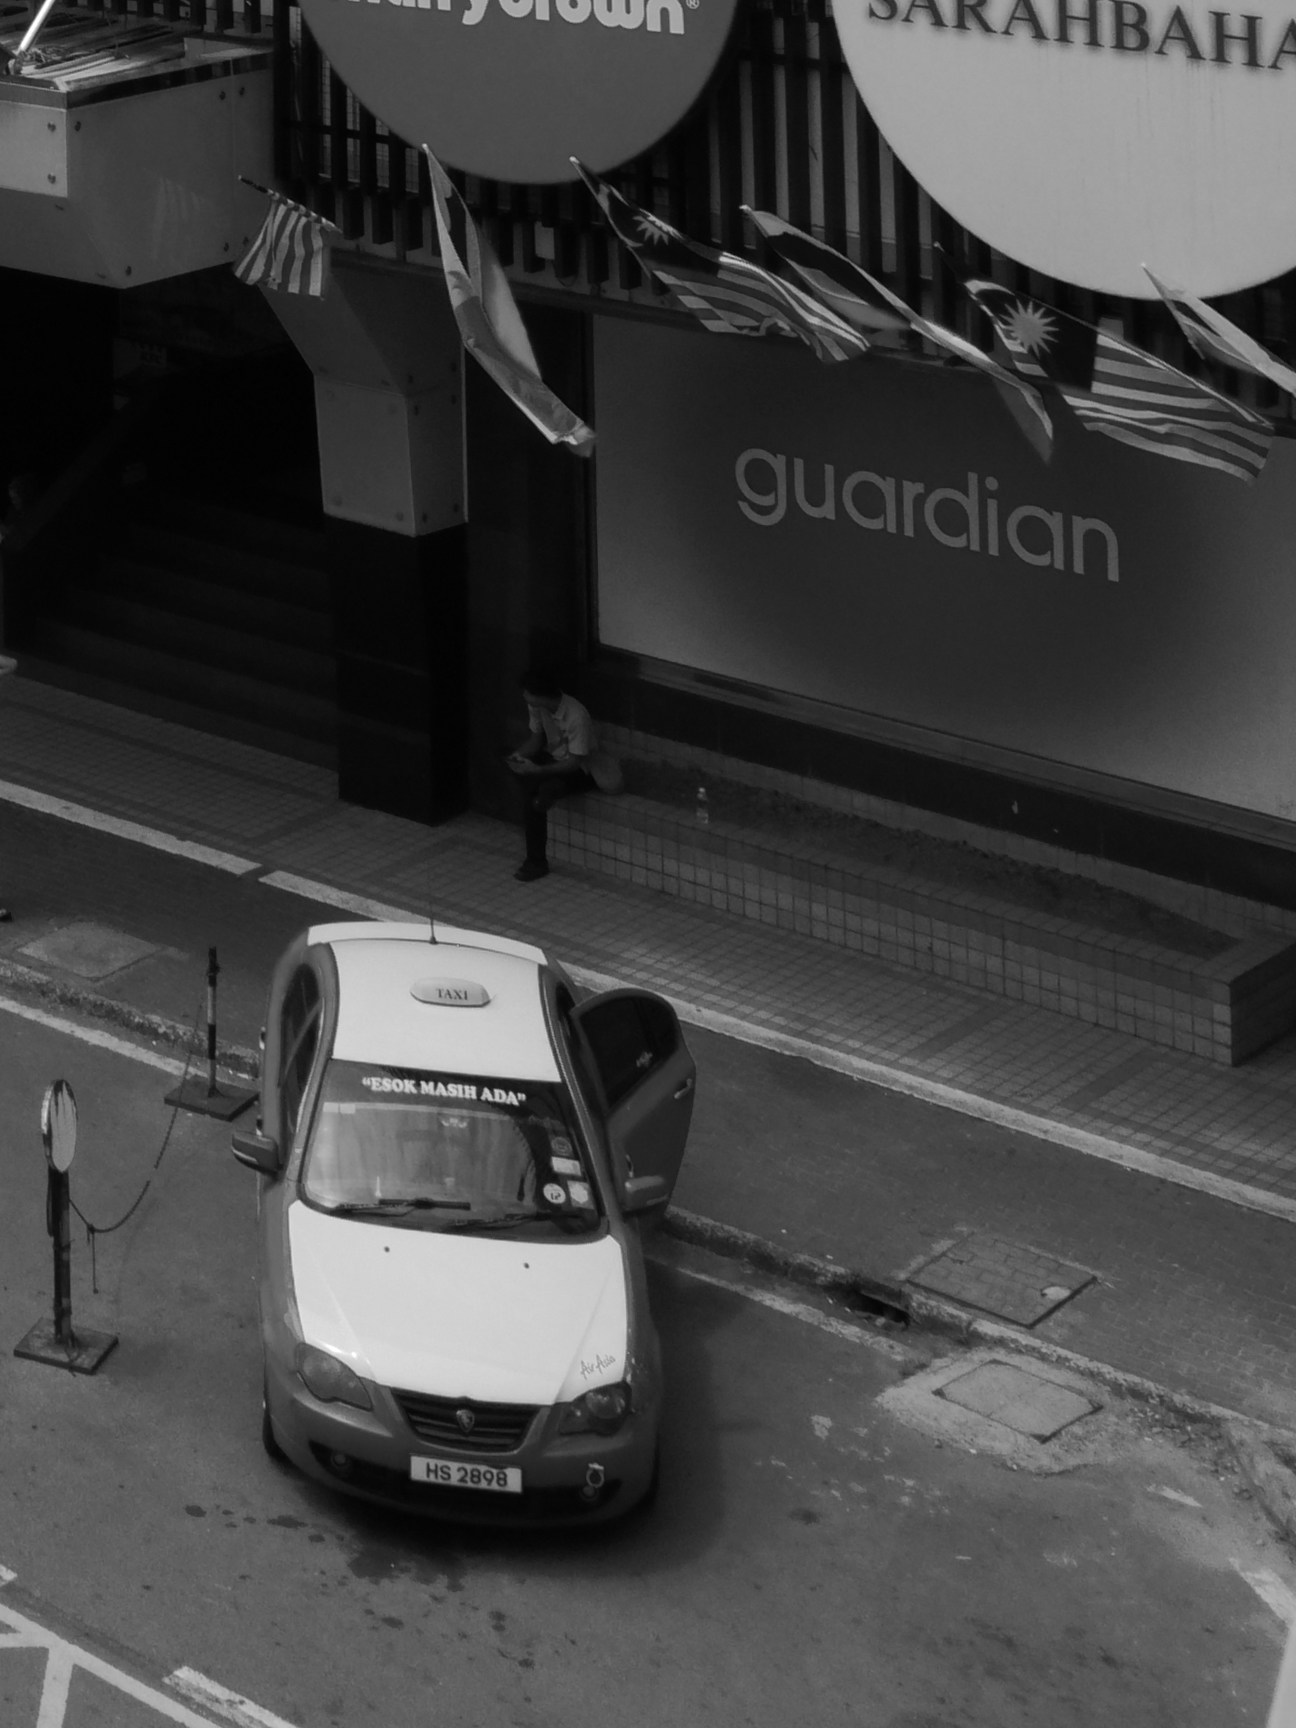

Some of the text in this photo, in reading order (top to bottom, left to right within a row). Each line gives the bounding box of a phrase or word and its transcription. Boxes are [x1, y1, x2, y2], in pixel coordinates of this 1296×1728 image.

[734, 447, 1121, 584] guardian
[436, 987, 469, 1001] TAXI
[420, 1079, 477, 1100] MASIH
[425, 1462, 509, 1488] HS 2898
